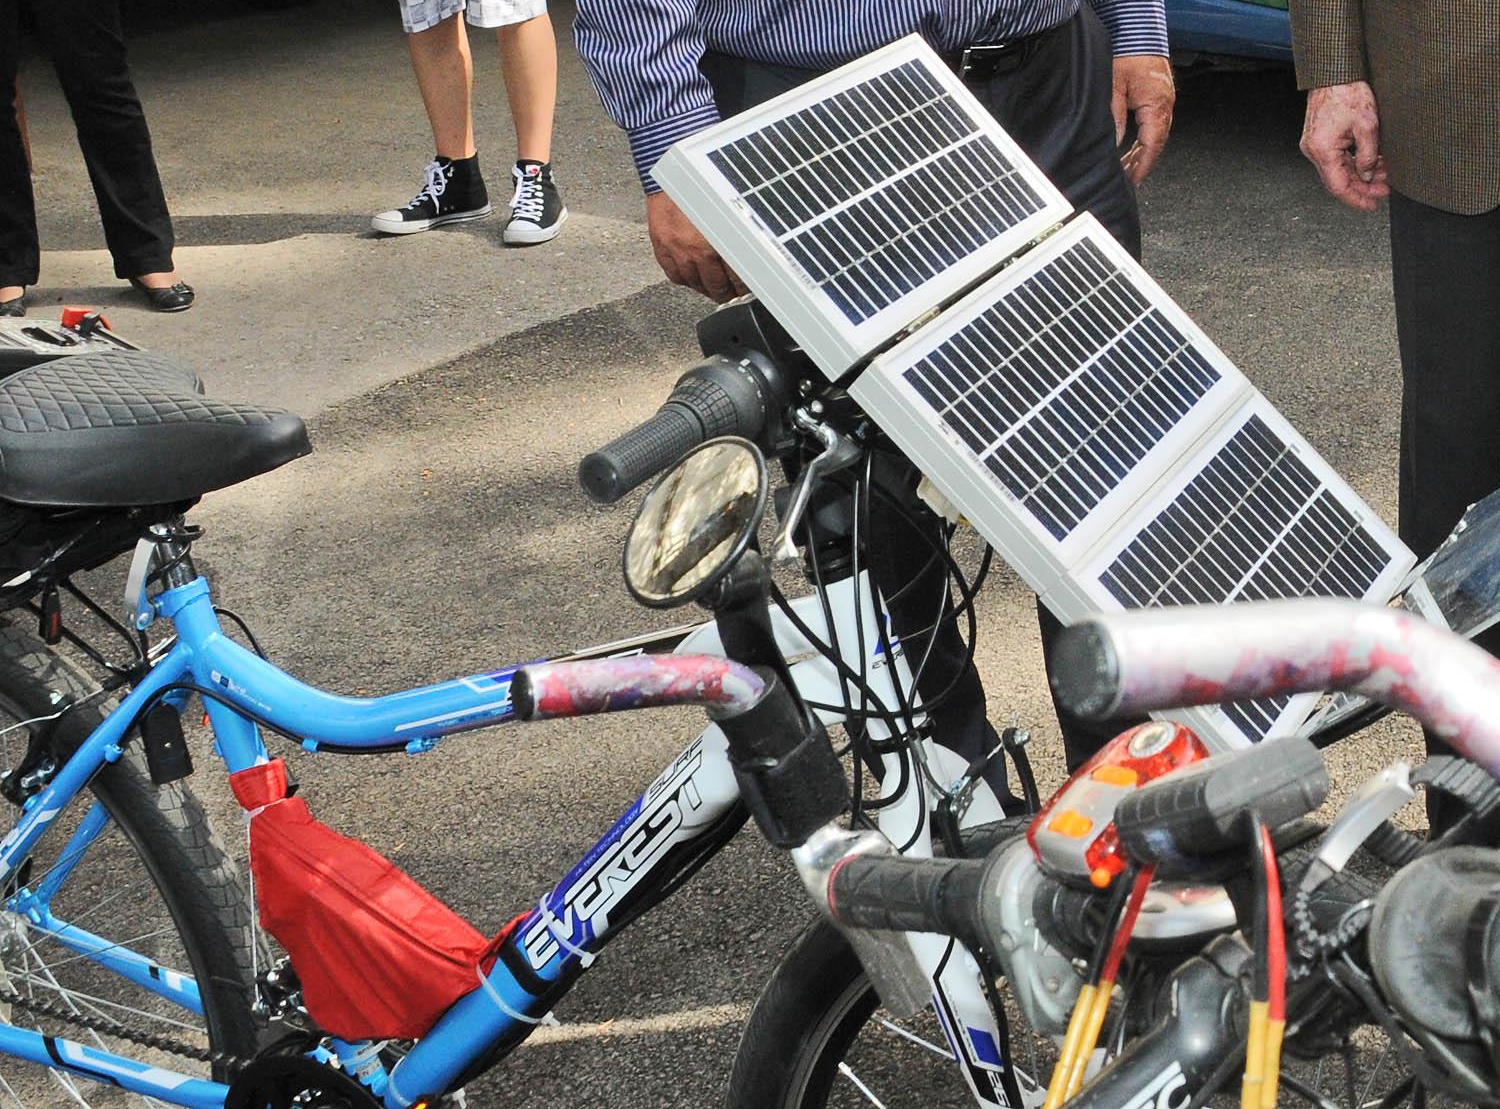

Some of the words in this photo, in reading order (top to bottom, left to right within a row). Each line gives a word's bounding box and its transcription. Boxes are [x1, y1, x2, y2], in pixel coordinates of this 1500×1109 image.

[649, 735, 704, 800] SURF
[524, 750, 703, 971] EVEREST
[986, 1070, 1011, 1108] 26
